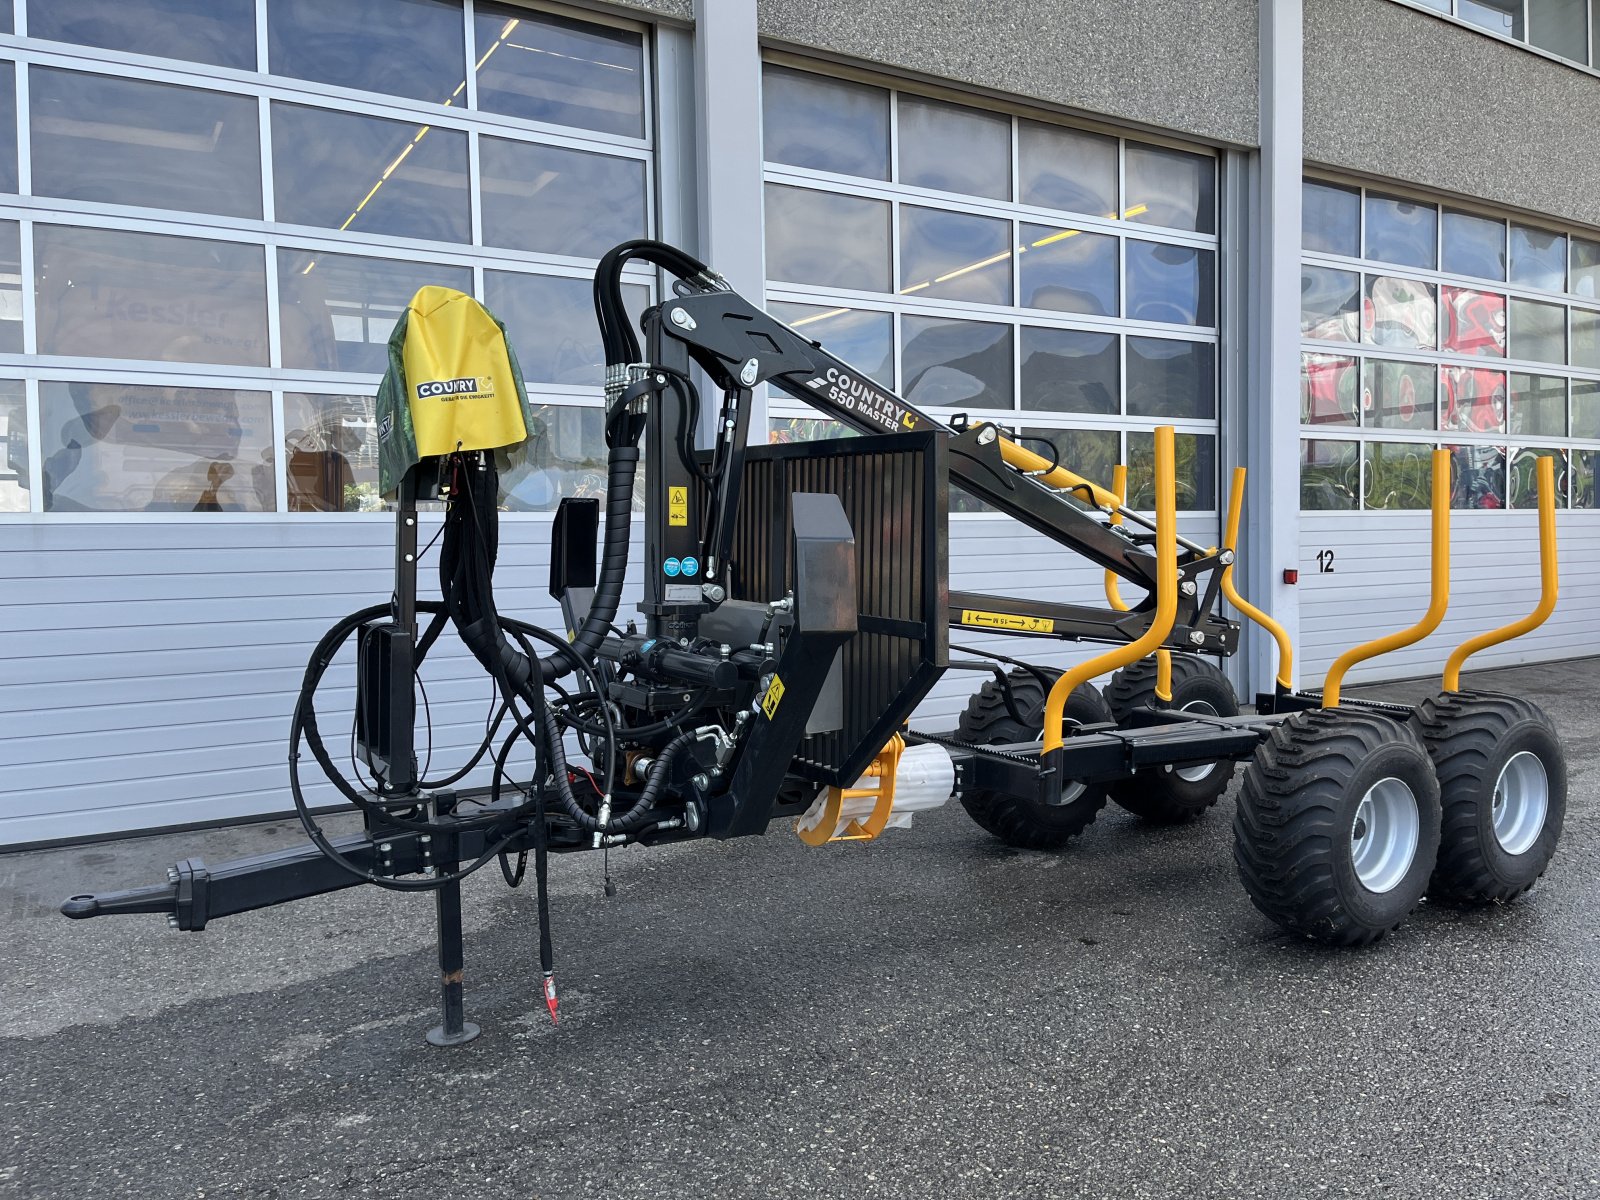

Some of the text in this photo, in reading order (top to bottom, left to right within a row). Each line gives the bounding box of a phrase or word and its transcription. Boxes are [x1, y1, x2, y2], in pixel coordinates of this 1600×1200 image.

[826, 367, 906, 421] COUNTRY
[828, 385, 900, 432] 550 MASTER
[1316, 549, 1335, 573] 12
